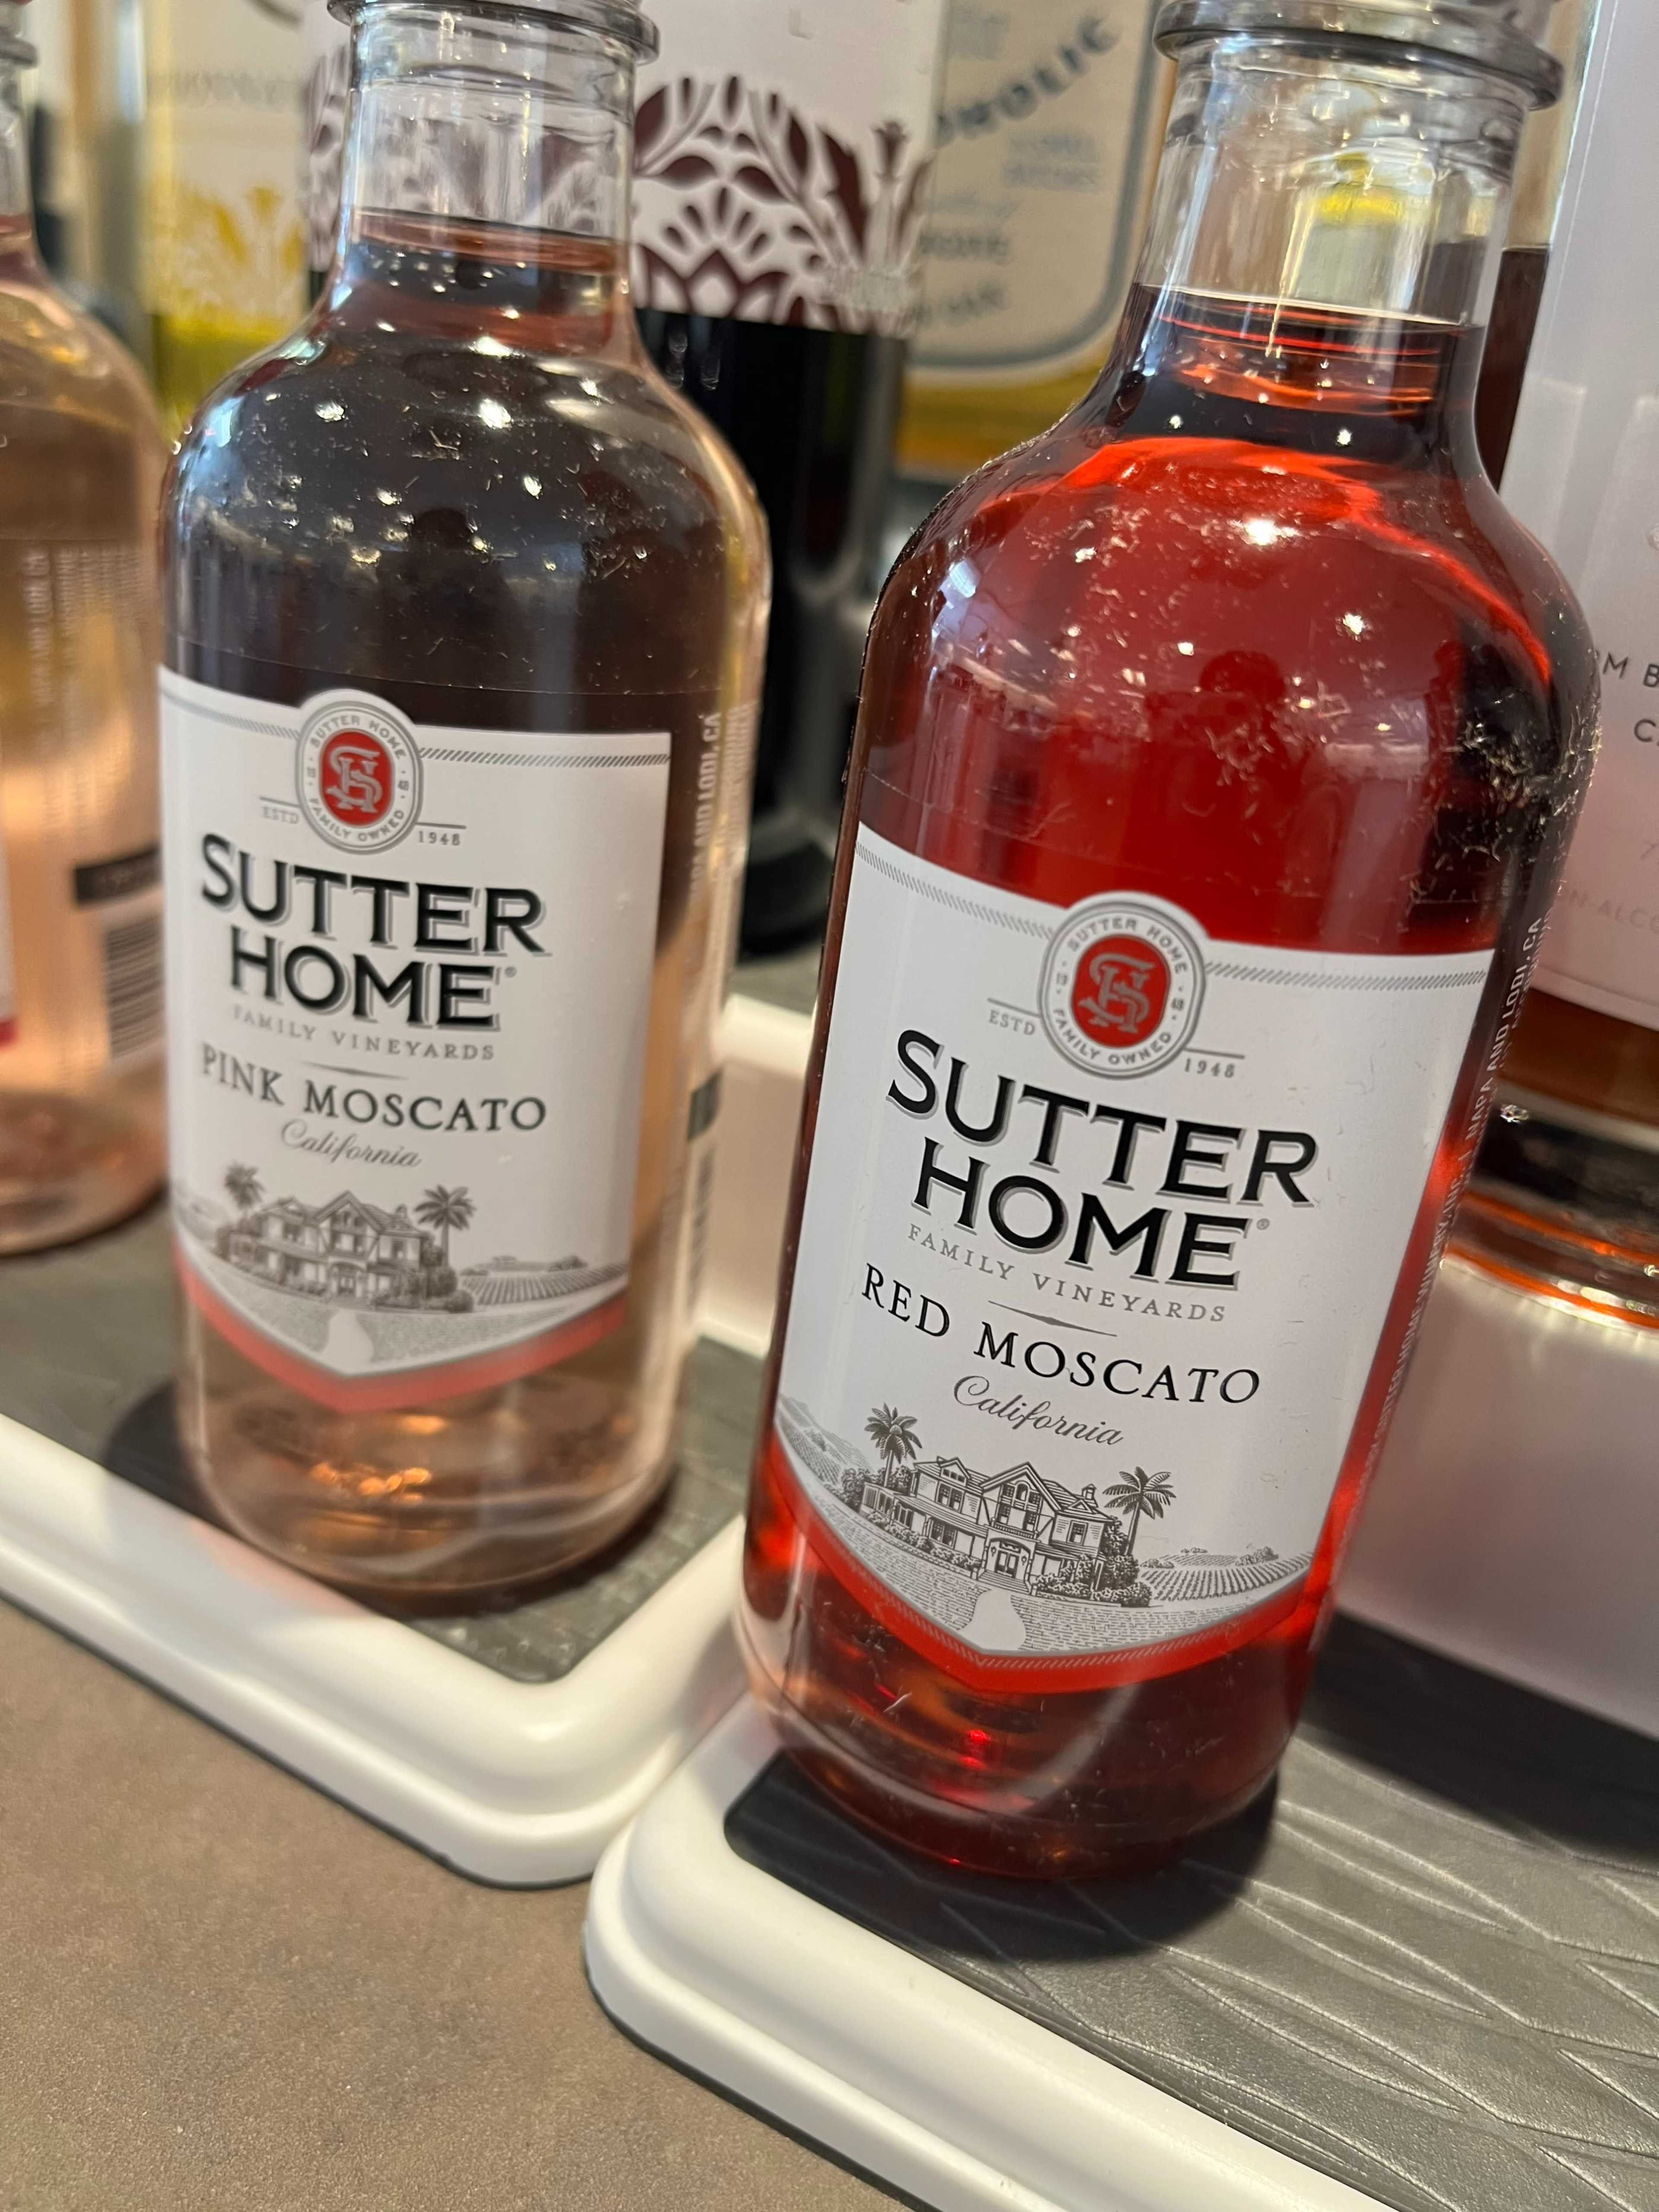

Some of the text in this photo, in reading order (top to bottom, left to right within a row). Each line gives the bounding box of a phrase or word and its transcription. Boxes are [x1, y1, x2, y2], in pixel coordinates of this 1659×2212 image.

[369, 720, 406, 759] HOME
[261, 806, 461, 846] ESTD 1948
[308, 798, 404, 842] FAMILY OWNED
[201, 833, 553, 957] SUTTER
[1068, 916, 1188, 975] SUTTER HOME
[232, 1003, 495, 1061] FAMILY VINEYARDS
[988, 1009, 1236, 1079] ESTD 1948
[1052, 1007, 1171, 1065] FAMILY OWNED
[1465, 1077, 1494, 1141] NAPA
[1486, 1024, 1510, 1071] AND
[1522, 917, 1541, 952] CA
[202, 1040, 546, 1131] PINK MOSCATO
[886, 1029, 1319, 1208] SUTTER
[280, 1118, 423, 1169] California
[908, 1224, 1226, 1322] FAMILY VINEYARDS
[862, 1262, 1260, 1404] RED MOSCATO
[953, 1374, 1124, 1446] California
